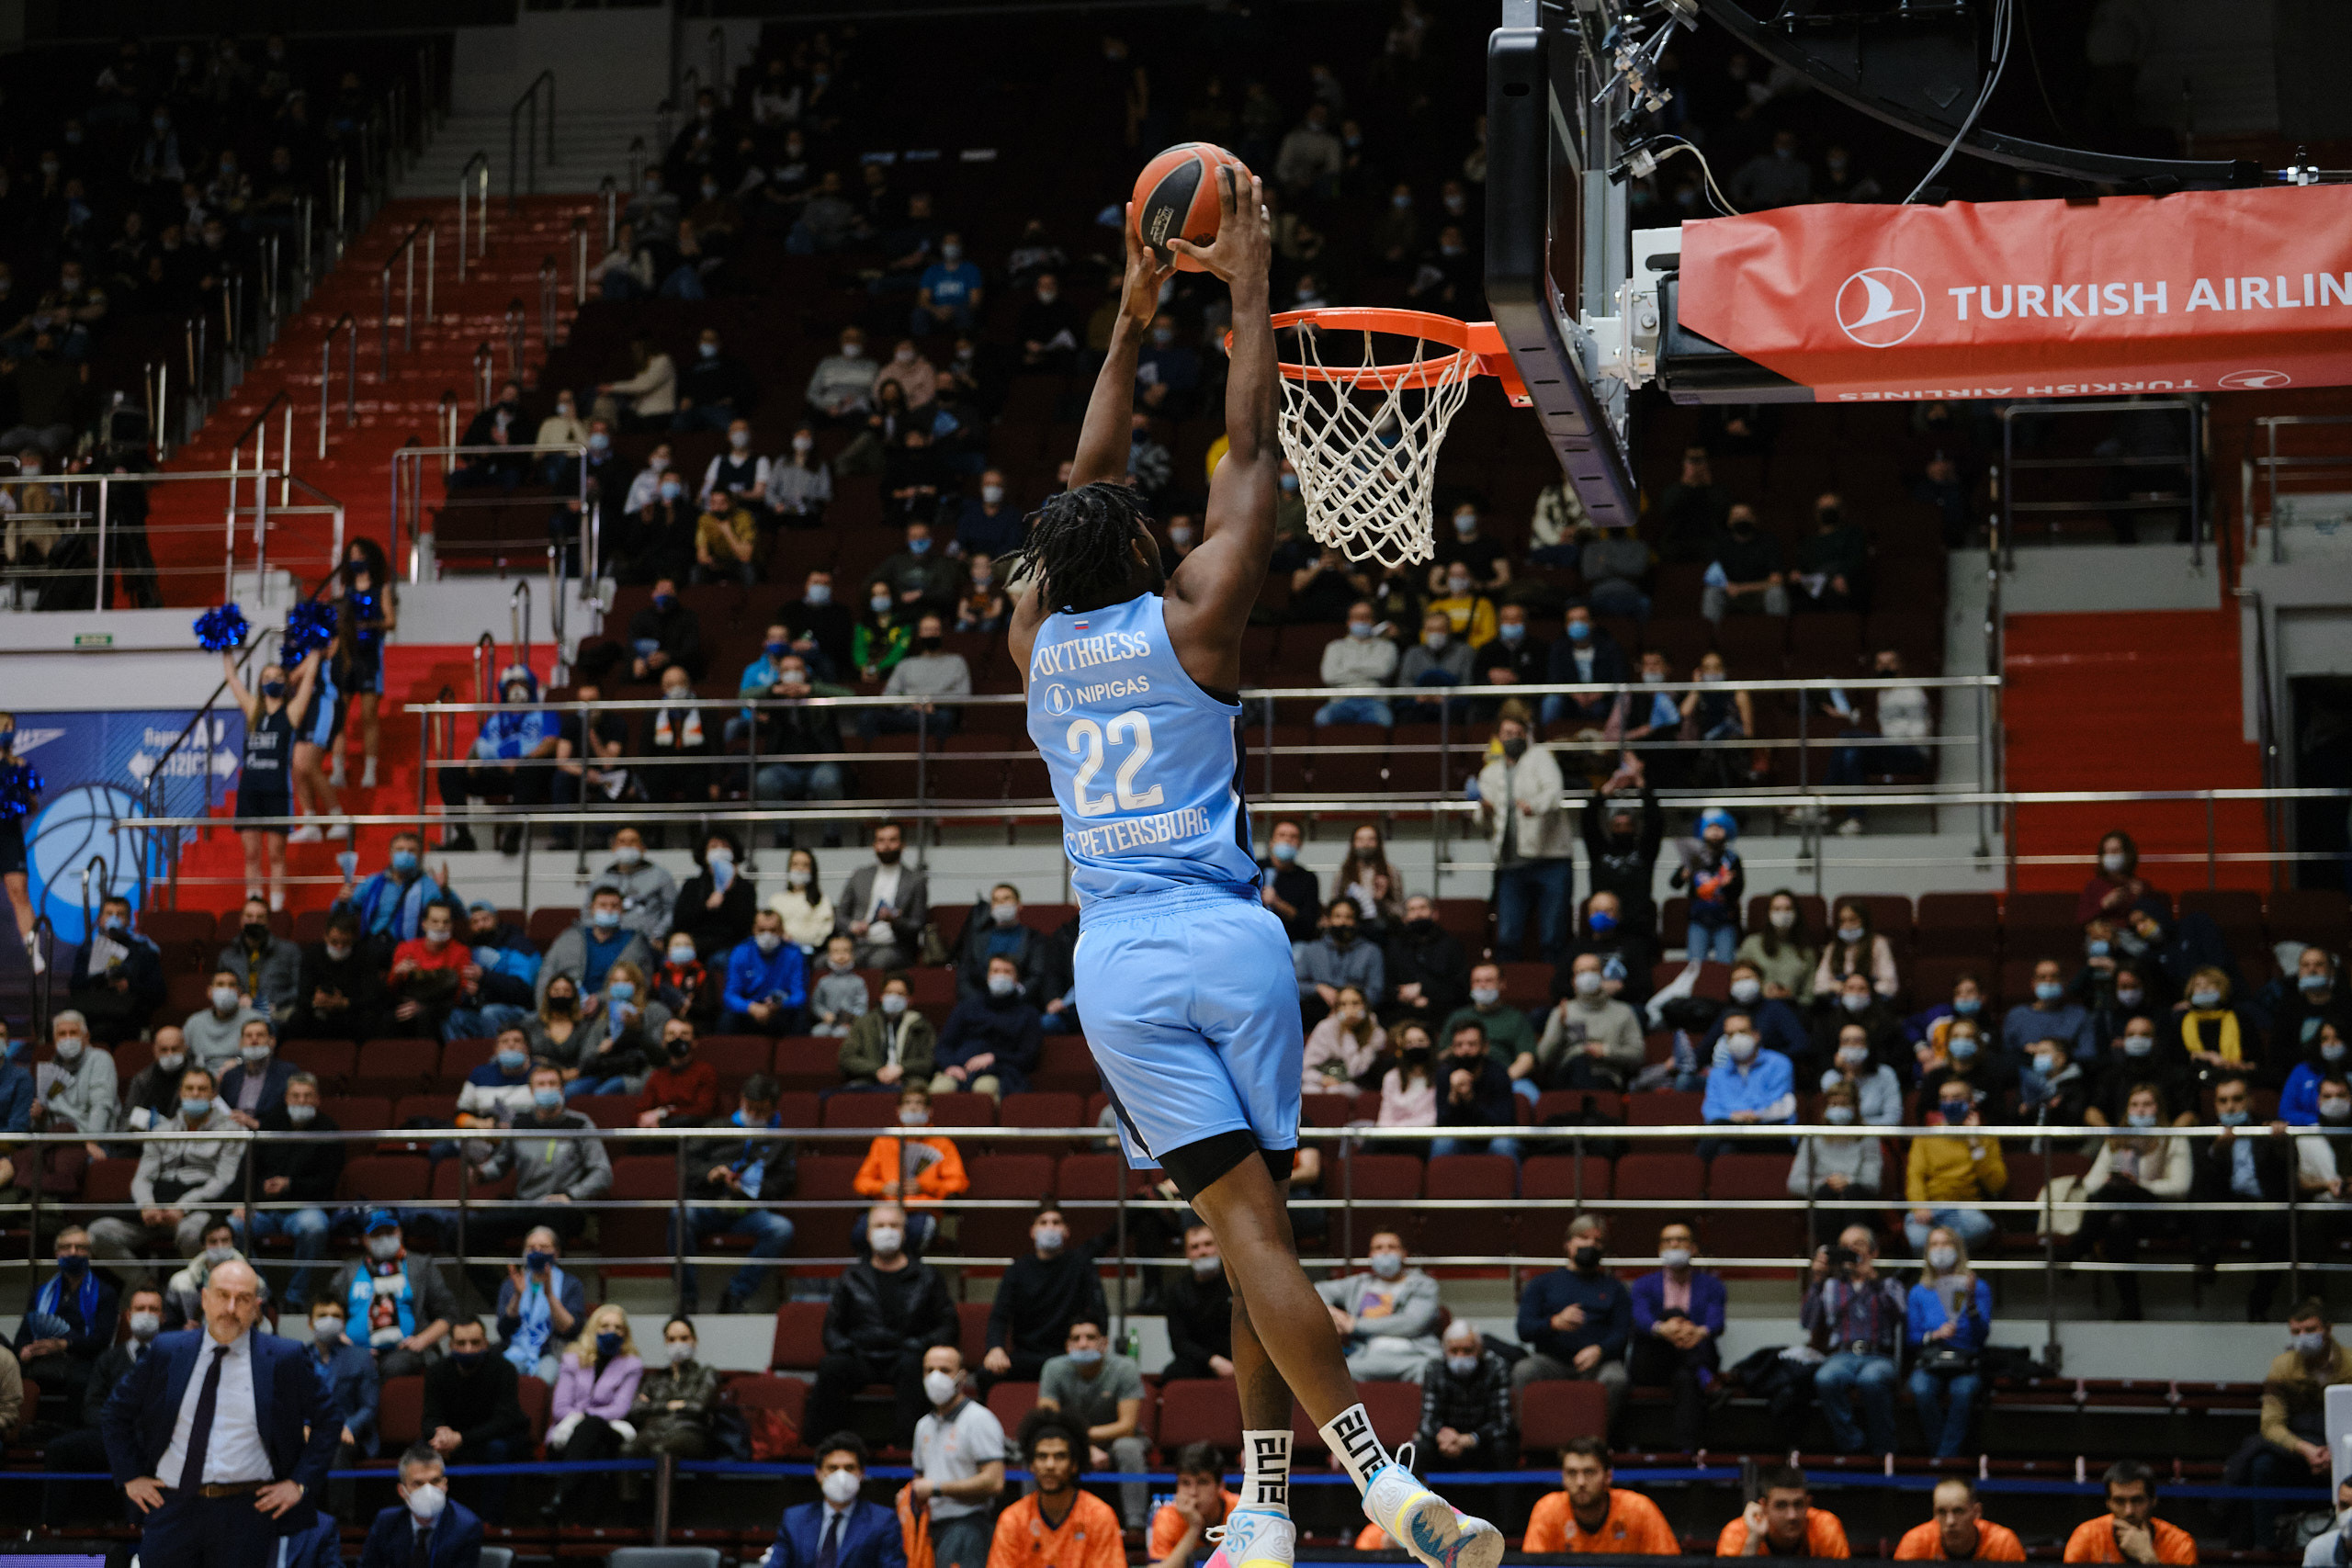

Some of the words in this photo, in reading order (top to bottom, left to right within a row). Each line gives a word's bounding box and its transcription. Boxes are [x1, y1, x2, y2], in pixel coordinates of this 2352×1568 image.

[1948, 280, 2168, 321] TURKISH
[2185, 272, 2352, 312] AIRLIN
[1838, 387, 2013, 401] AIRLINES
[2027, 379, 2199, 395] TURKISH
[1076, 675, 1150, 705] NIPIGAS
[1066, 710, 1165, 818] 22
[1078, 806, 1212, 858] PETERSBURG
[1253, 1437, 1286, 1504] ELITE
